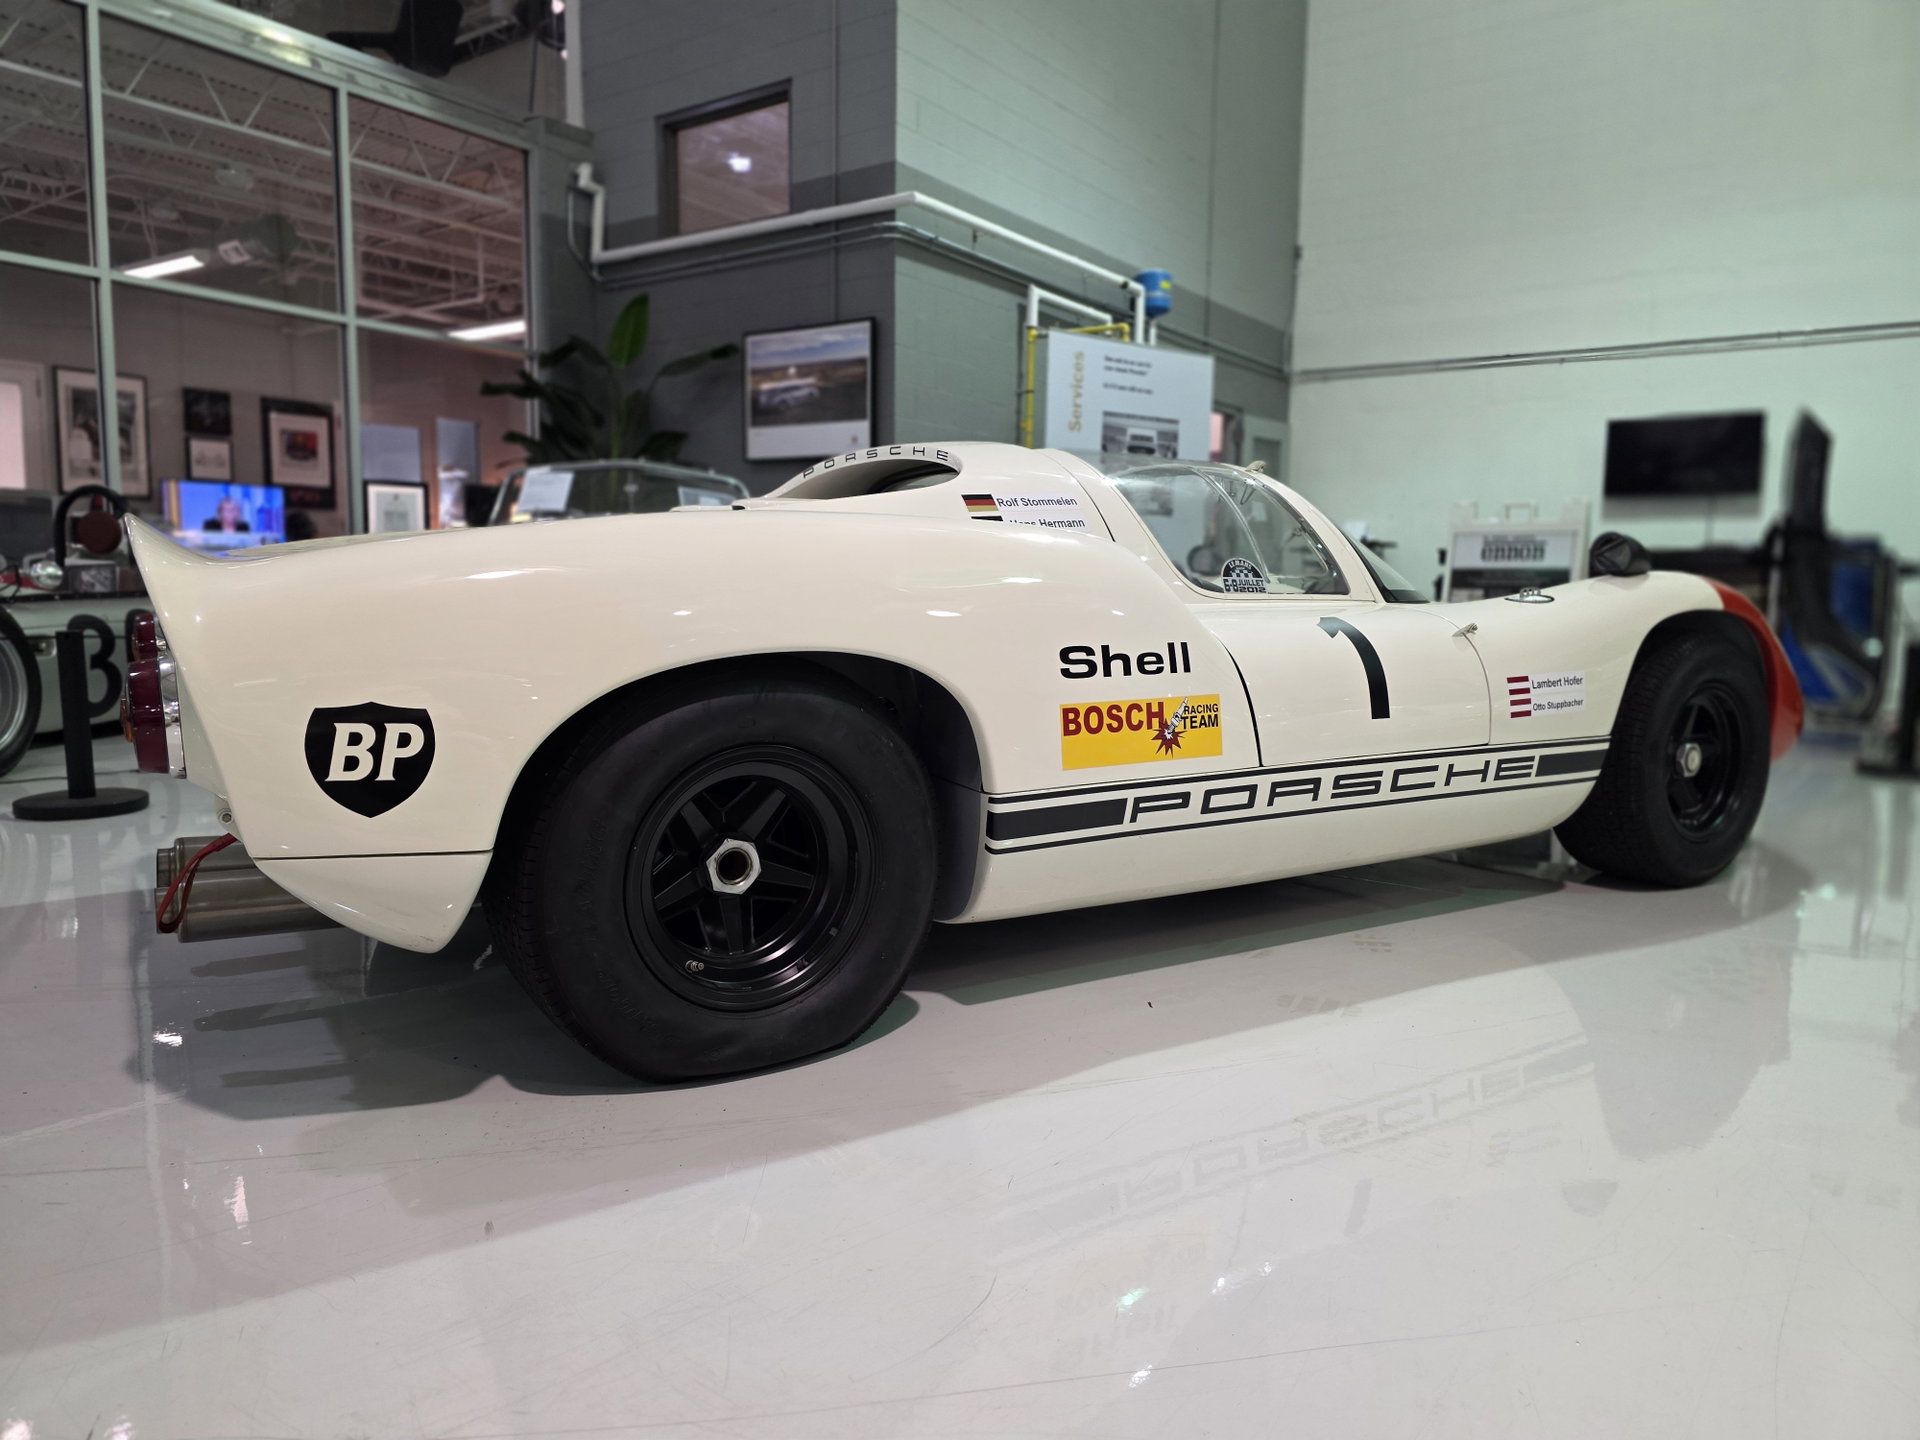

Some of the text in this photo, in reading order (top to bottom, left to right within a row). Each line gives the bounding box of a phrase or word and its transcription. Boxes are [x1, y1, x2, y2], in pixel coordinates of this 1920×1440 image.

[1068, 351, 1084, 432] Services
[802, 445, 949, 479] PORSCHE
[996, 498, 1019, 507] Rolf
[1038, 518, 1086, 528] Hermann
[1059, 642, 1191, 679] Shell
[1316, 616, 1390, 719] 1
[1531, 676, 1583, 689] Lambert Hofer
[1062, 701, 1165, 736] BOSCH
[1181, 714, 1219, 730] TEAM
[1184, 703, 1219, 715] RACING
[1532, 703, 1546, 711] Otto
[324, 722, 425, 781] BP
[1129, 755, 1536, 824] PORSCHE
